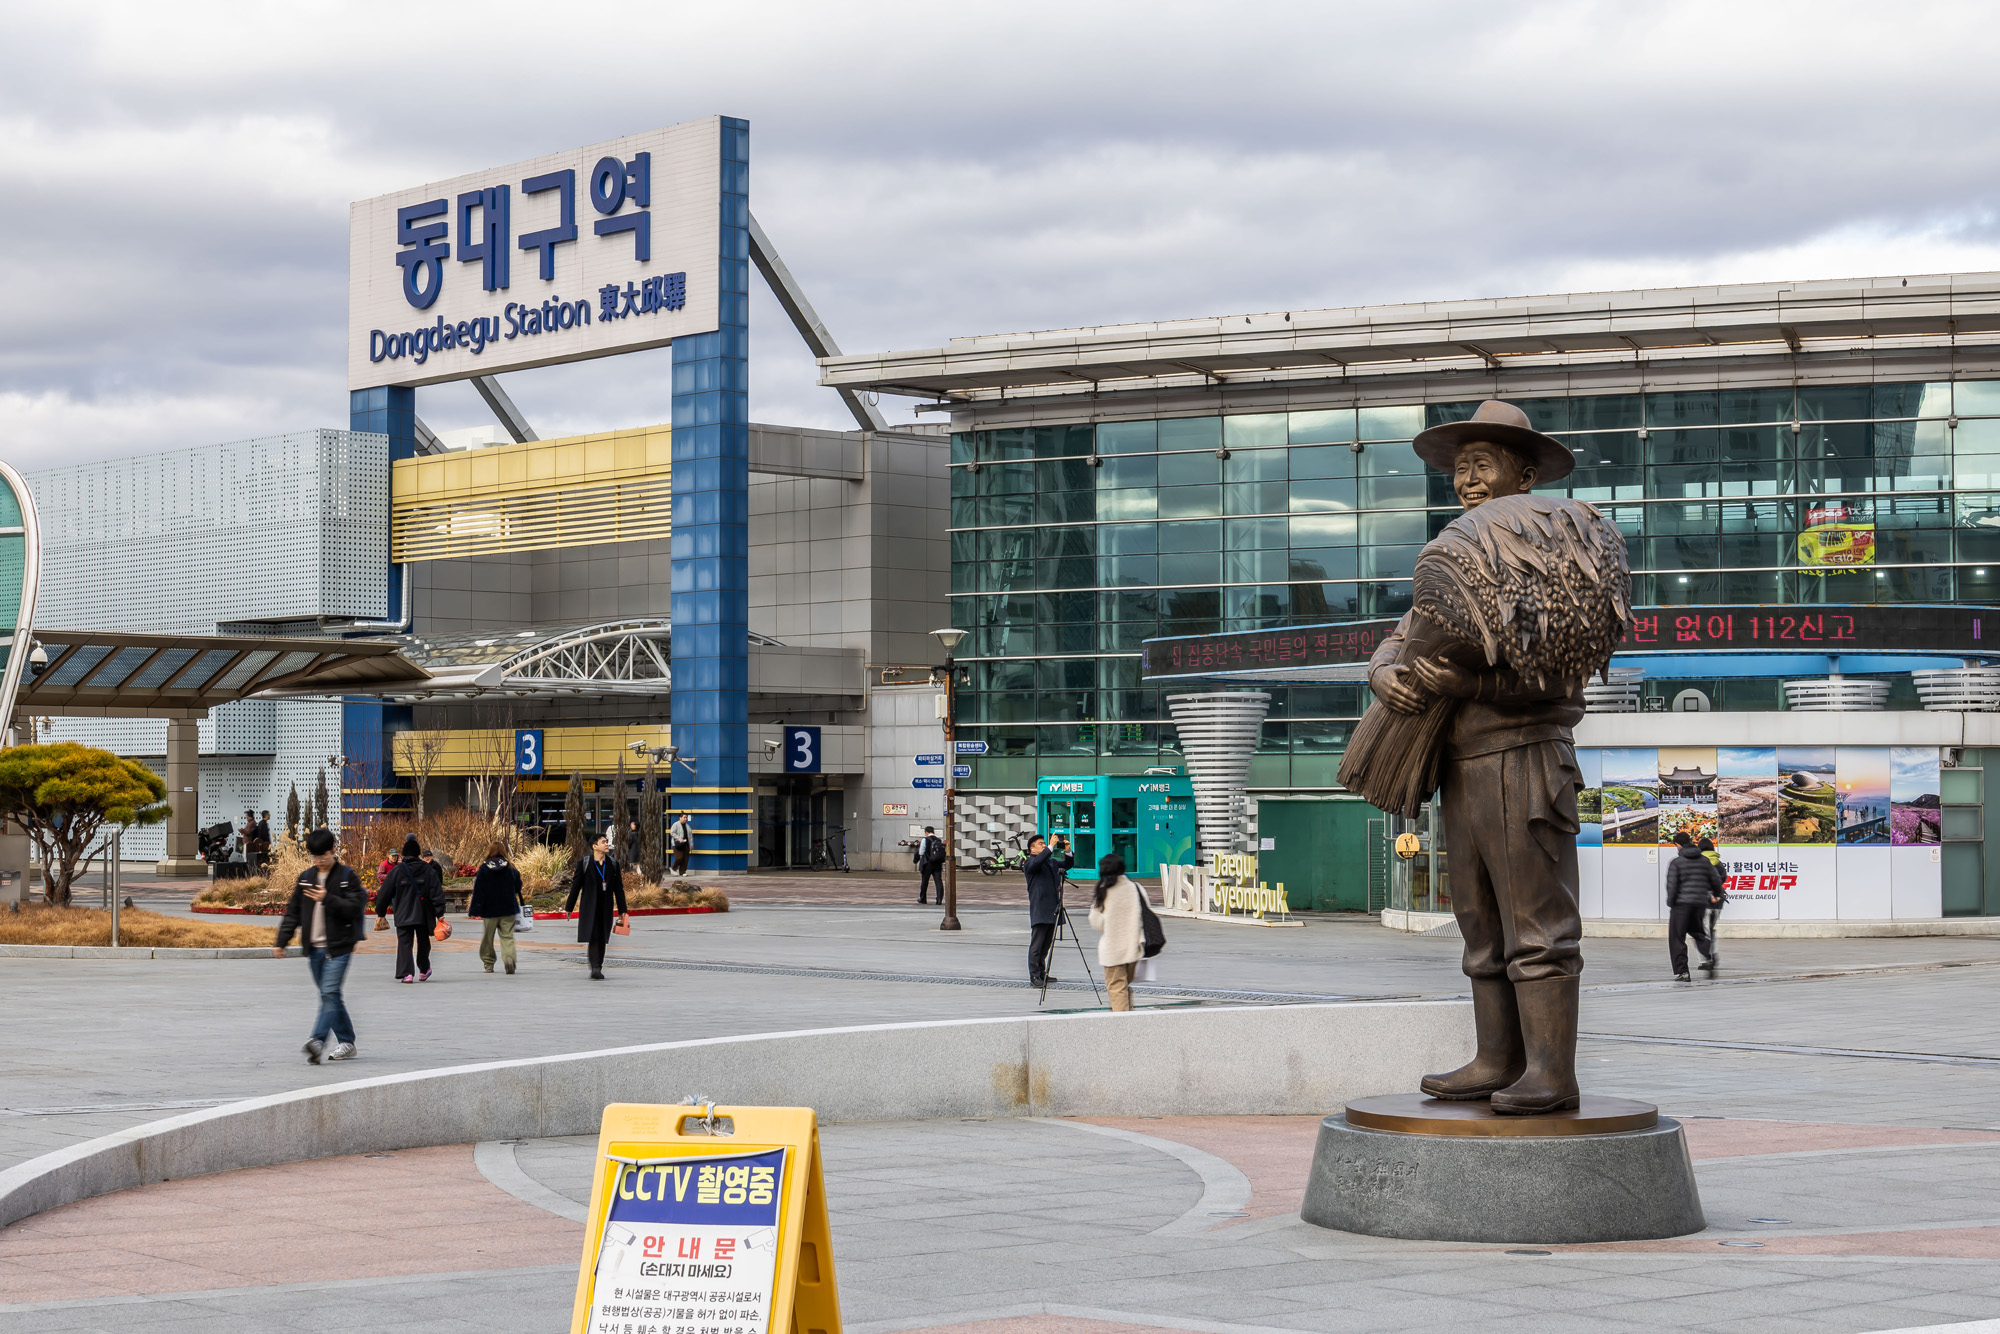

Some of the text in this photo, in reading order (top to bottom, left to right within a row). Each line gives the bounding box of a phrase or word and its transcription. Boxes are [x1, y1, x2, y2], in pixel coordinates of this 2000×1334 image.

[395, 151, 651, 310] 동대구역
[370, 271, 687, 364] Dongdaegu Station 東大邱驛
[1187, 641, 1243, 667] 집중단속
[1249, 635, 1306, 662] 국민들의
[1314, 629, 1375, 658] 적극적인
[1622, 615, 1658, 642] 번
[1675, 614, 1733, 641] 없이
[1749, 614, 1856, 641] 112신고
[521, 733, 537, 771] 3
[793, 730, 813, 769] 3
[1062, 783, 1083, 792] iM뱅크
[1150, 784, 1170, 792] iM뱅크
[1213, 850, 1255, 885] Daegu
[1722, 875, 1798, 890] 워풀 대구
[1733, 862, 1763, 873] 활력이
[1767, 862, 1798, 873] 넘치는
[1160, 863, 1289, 919] VISIT Gyeongbuk
[617, 1164, 775, 1206] CCTV 촬영중
[640, 1261, 733, 1279] (손대지 마세요)
[614, 1287, 762, 1304] 현 시설물은 대구광역시 공공시설로서
[601, 1305, 762, 1322] 현행법상(공공)기물을 허가 없이 파손,
